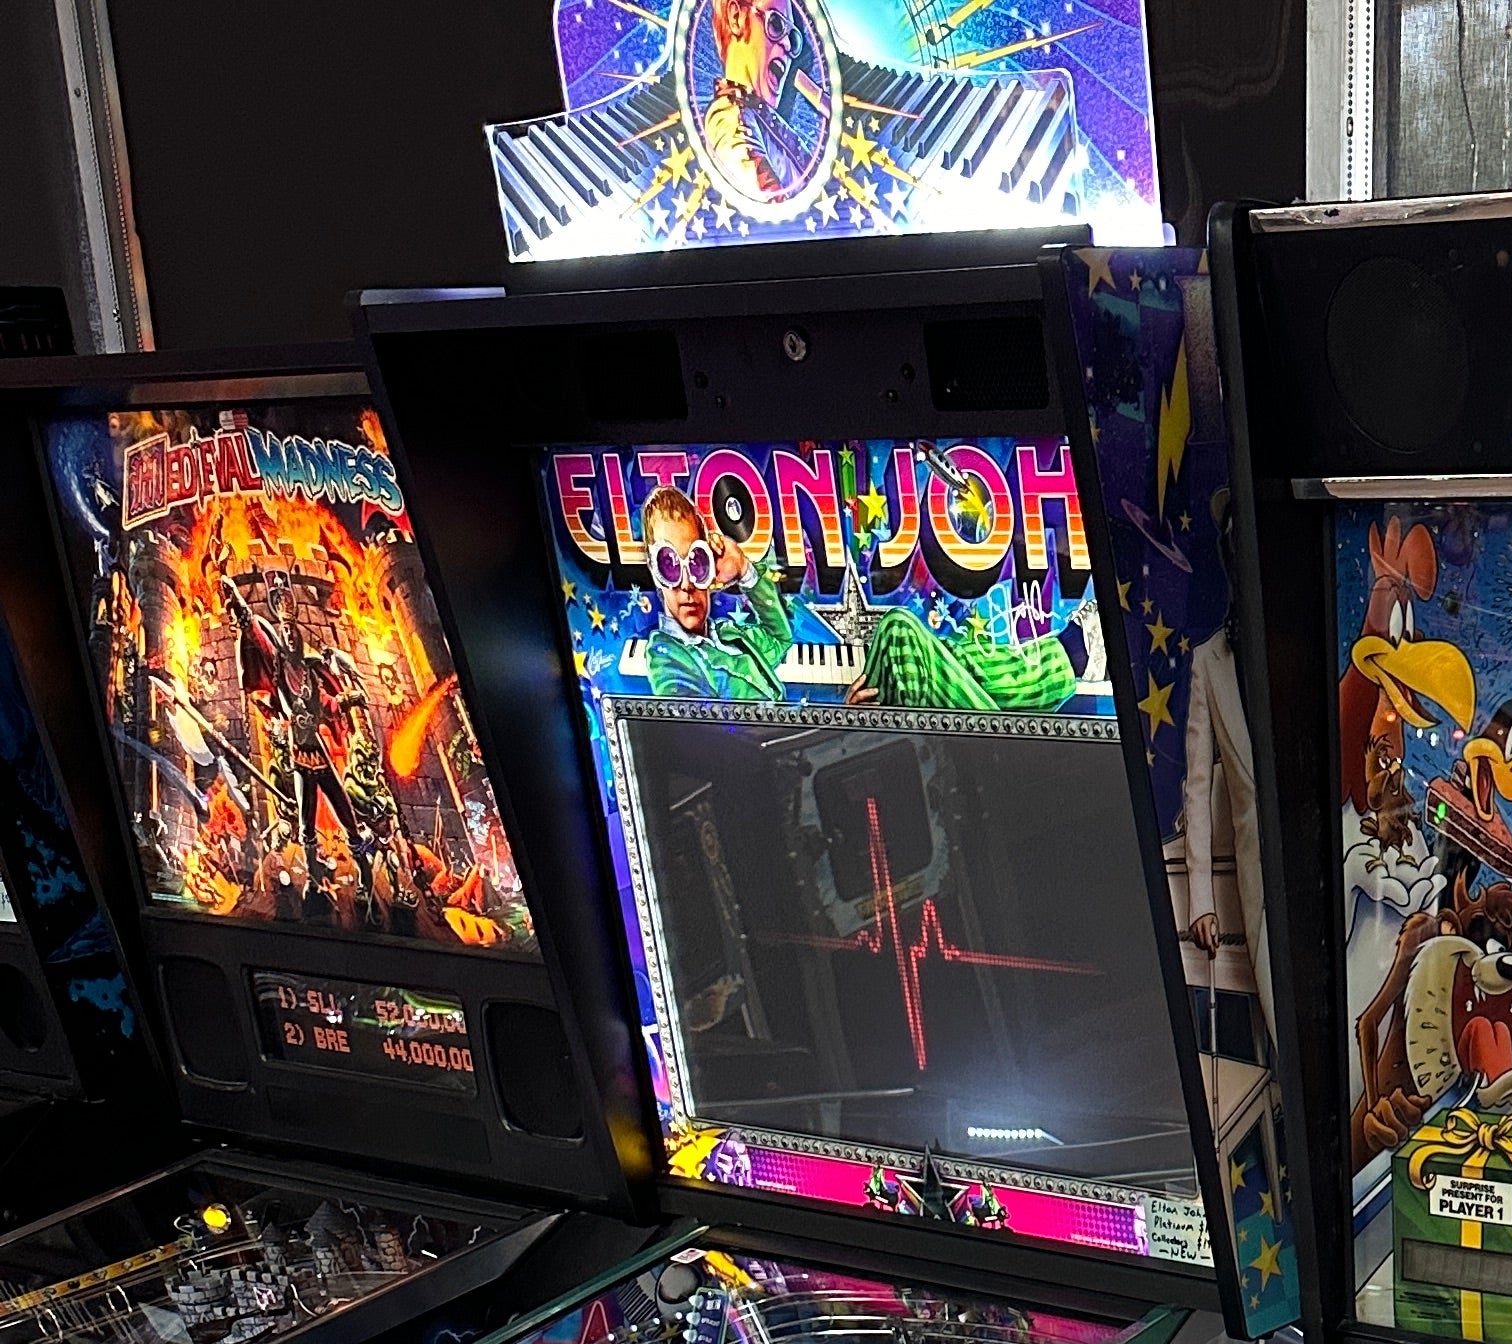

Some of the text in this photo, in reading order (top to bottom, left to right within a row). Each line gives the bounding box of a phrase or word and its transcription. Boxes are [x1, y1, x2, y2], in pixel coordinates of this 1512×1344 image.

[124, 426, 405, 528] MEDIEVAL MADNESS
[554, 448, 848, 568] ELTON
[284, 1022, 305, 1045] 2)
[313, 1026, 350, 1053] BRE
[1442, 1188, 1504, 1205] PRESENT FOR
[1450, 1180, 1495, 1195] SURPRISE
[1151, 1200, 1178, 1215] Elton
[1439, 1198, 1504, 1221] PLAYER 1
[1154, 1215, 1194, 1232] Platinum
